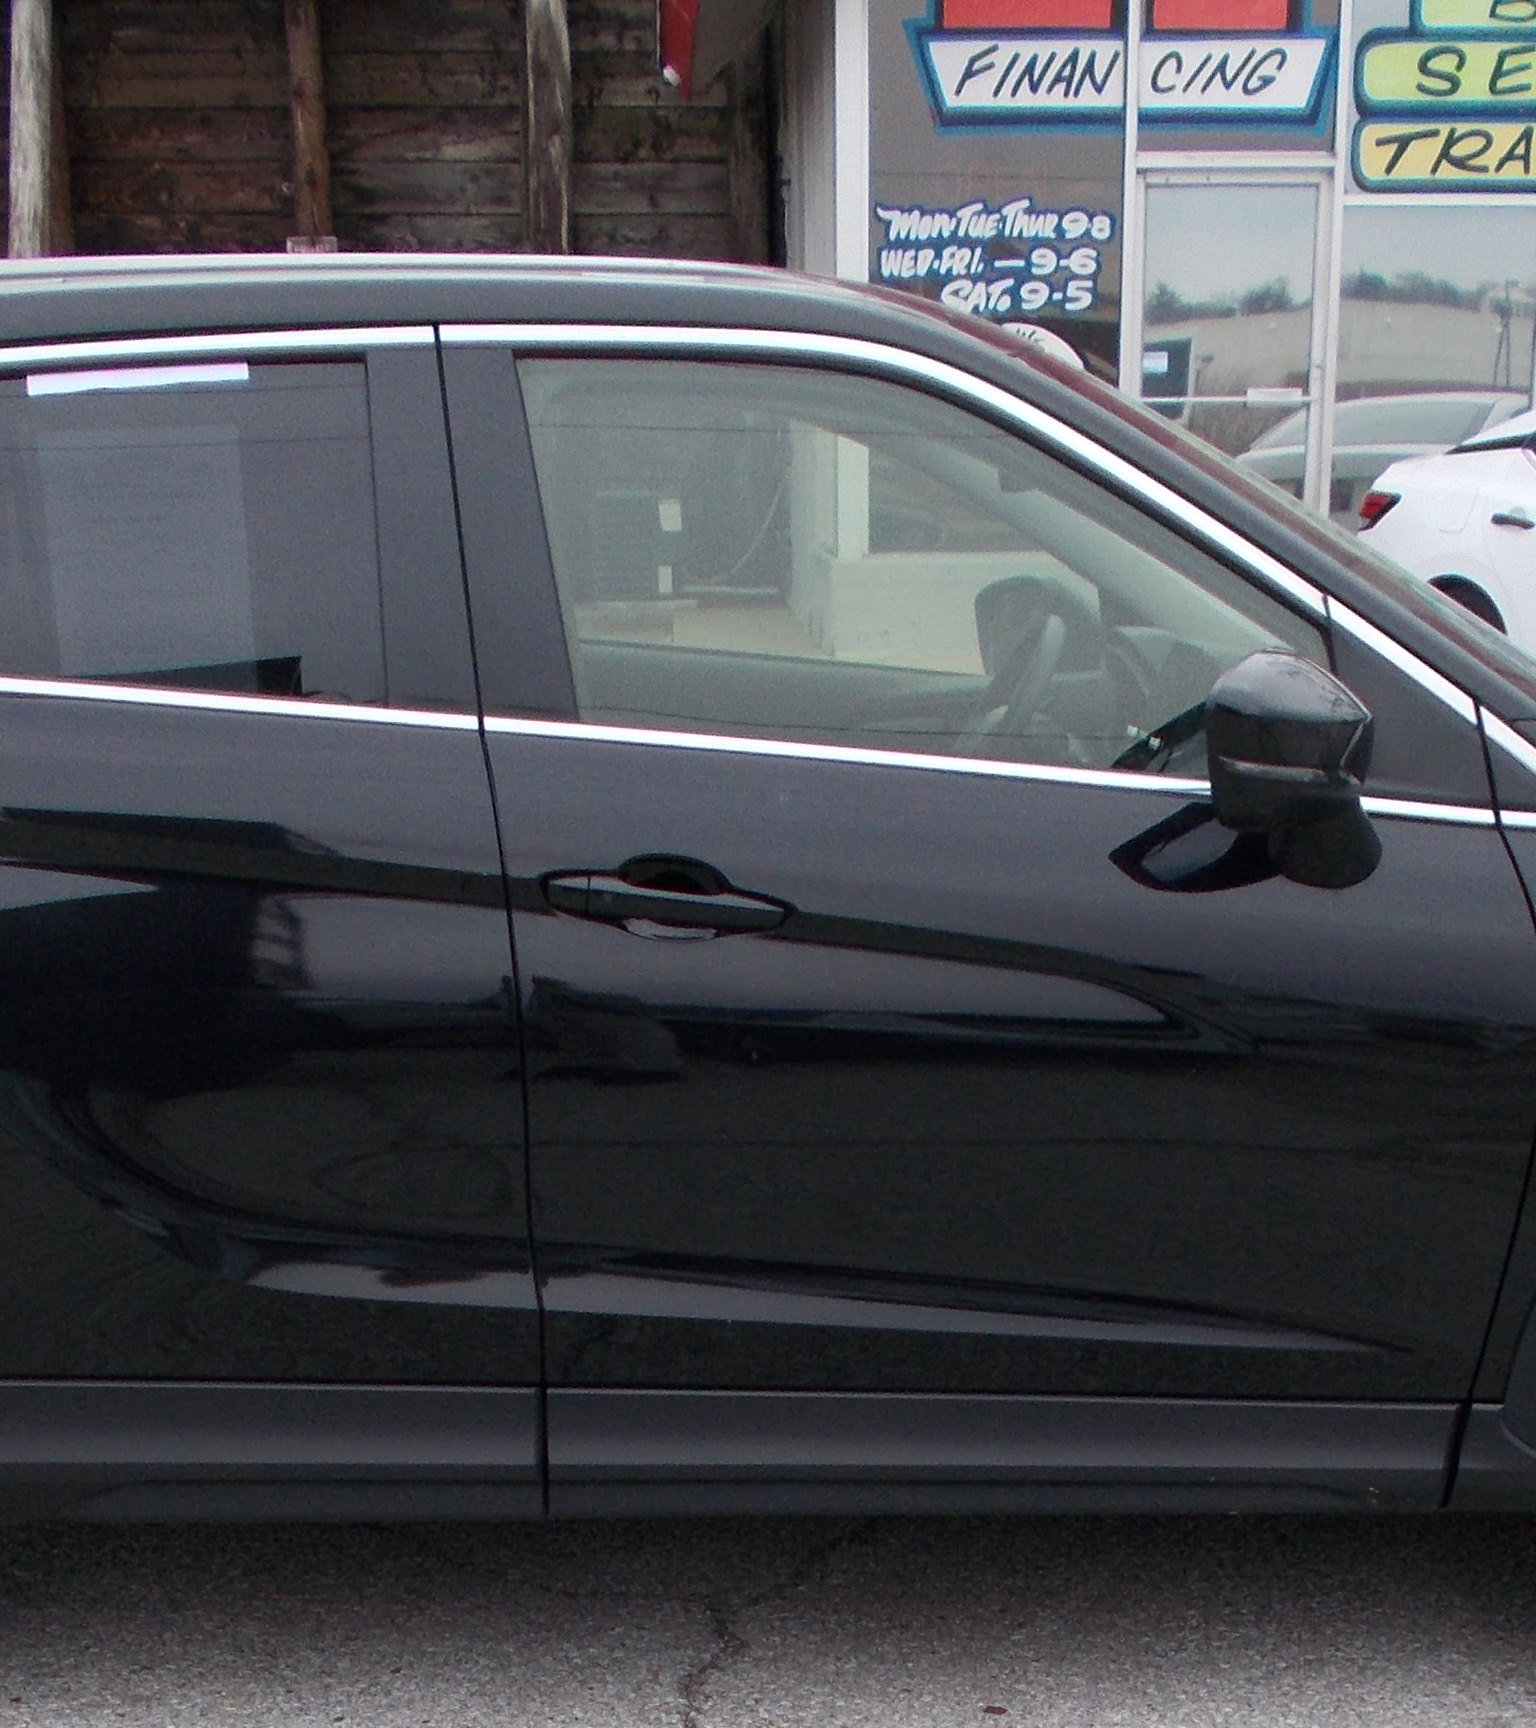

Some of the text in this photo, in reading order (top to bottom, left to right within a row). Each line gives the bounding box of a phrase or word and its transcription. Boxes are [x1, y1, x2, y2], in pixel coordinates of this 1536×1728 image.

[955, 43, 1289, 99] FINANCING
[1031, 248, 1097, 275] 9-6
[1020, 280, 1093, 310] 9-5
